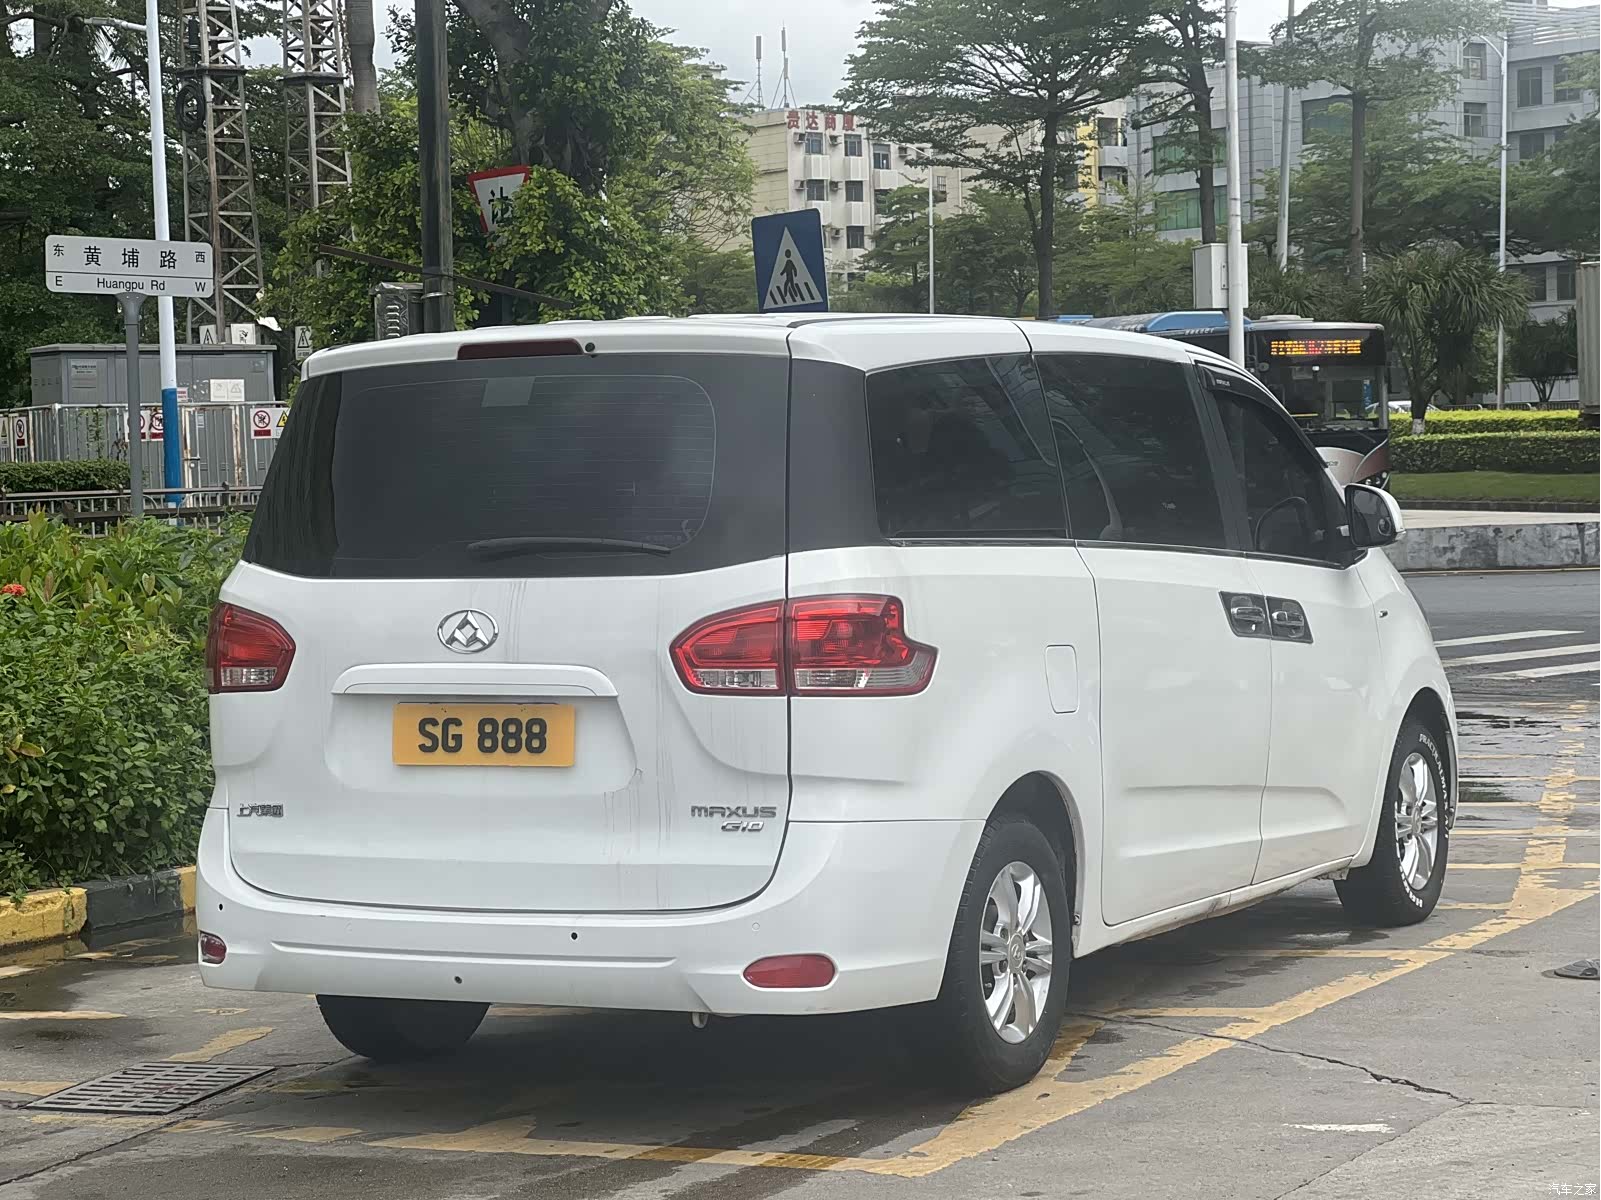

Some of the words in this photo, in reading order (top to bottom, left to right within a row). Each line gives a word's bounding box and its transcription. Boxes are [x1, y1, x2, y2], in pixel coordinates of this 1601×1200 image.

[53, 244, 64, 257] 东
[83, 246, 177, 269] 黄埔路
[195, 251, 206, 263] 西
[55, 276, 63, 286] E
[97, 278, 144, 291] Huangpu
[151, 280, 165, 291] Rd
[195, 282, 206, 292] W
[418, 717, 463, 753] SG
[477, 717, 547, 754] 888
[691, 805, 777, 818] MAXUS
[721, 821, 764, 832] G10
